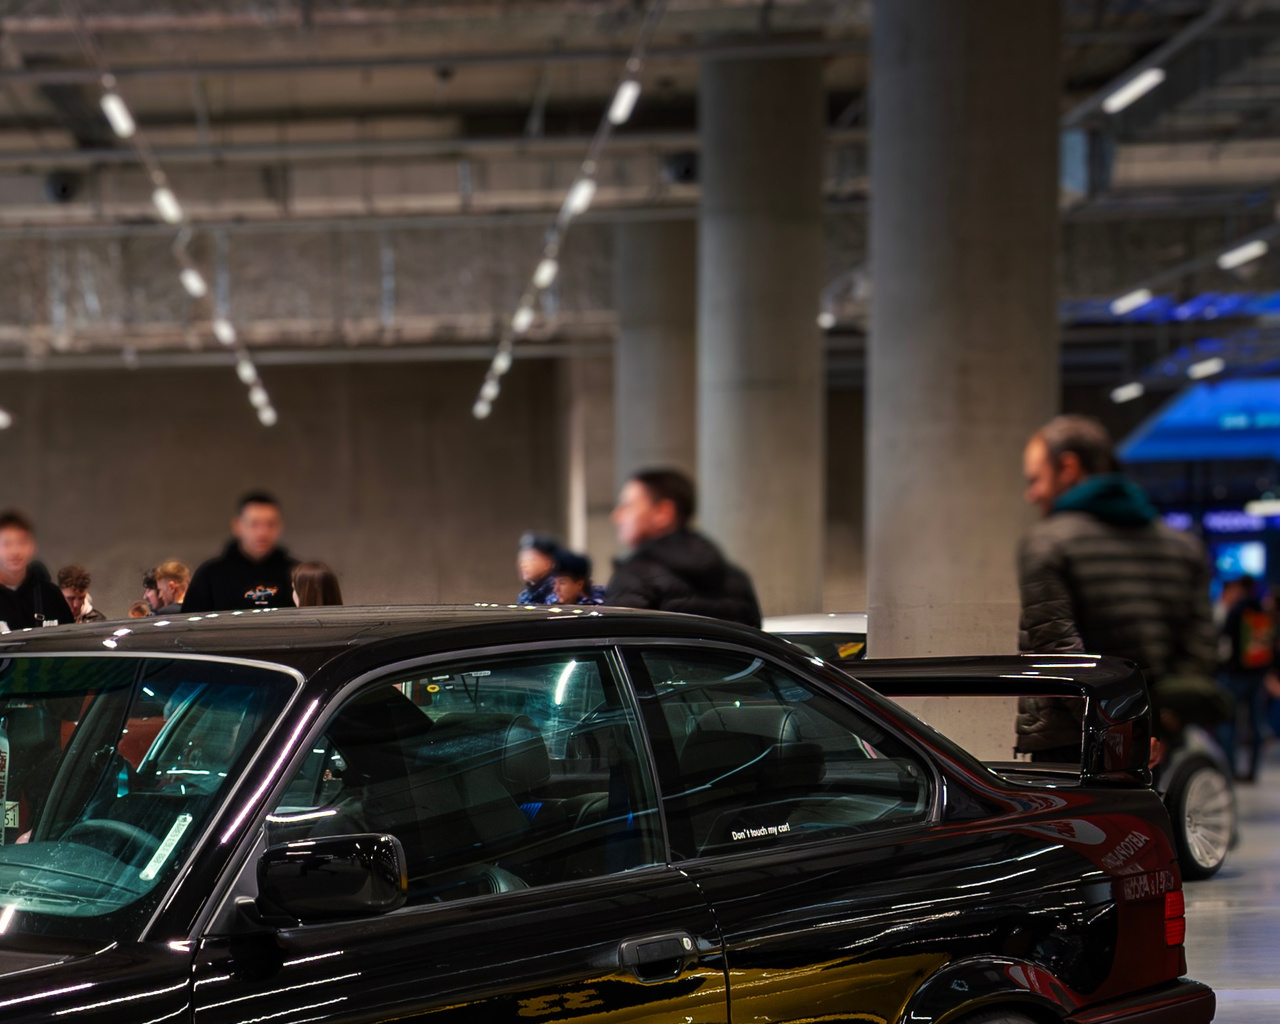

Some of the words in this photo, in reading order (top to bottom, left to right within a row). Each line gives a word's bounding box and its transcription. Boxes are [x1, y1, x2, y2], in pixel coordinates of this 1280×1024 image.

[731, 829, 750, 840] Don't
[750, 826, 767, 837] touch
[767, 826, 778, 836] my
[778, 822, 790, 833] car!
